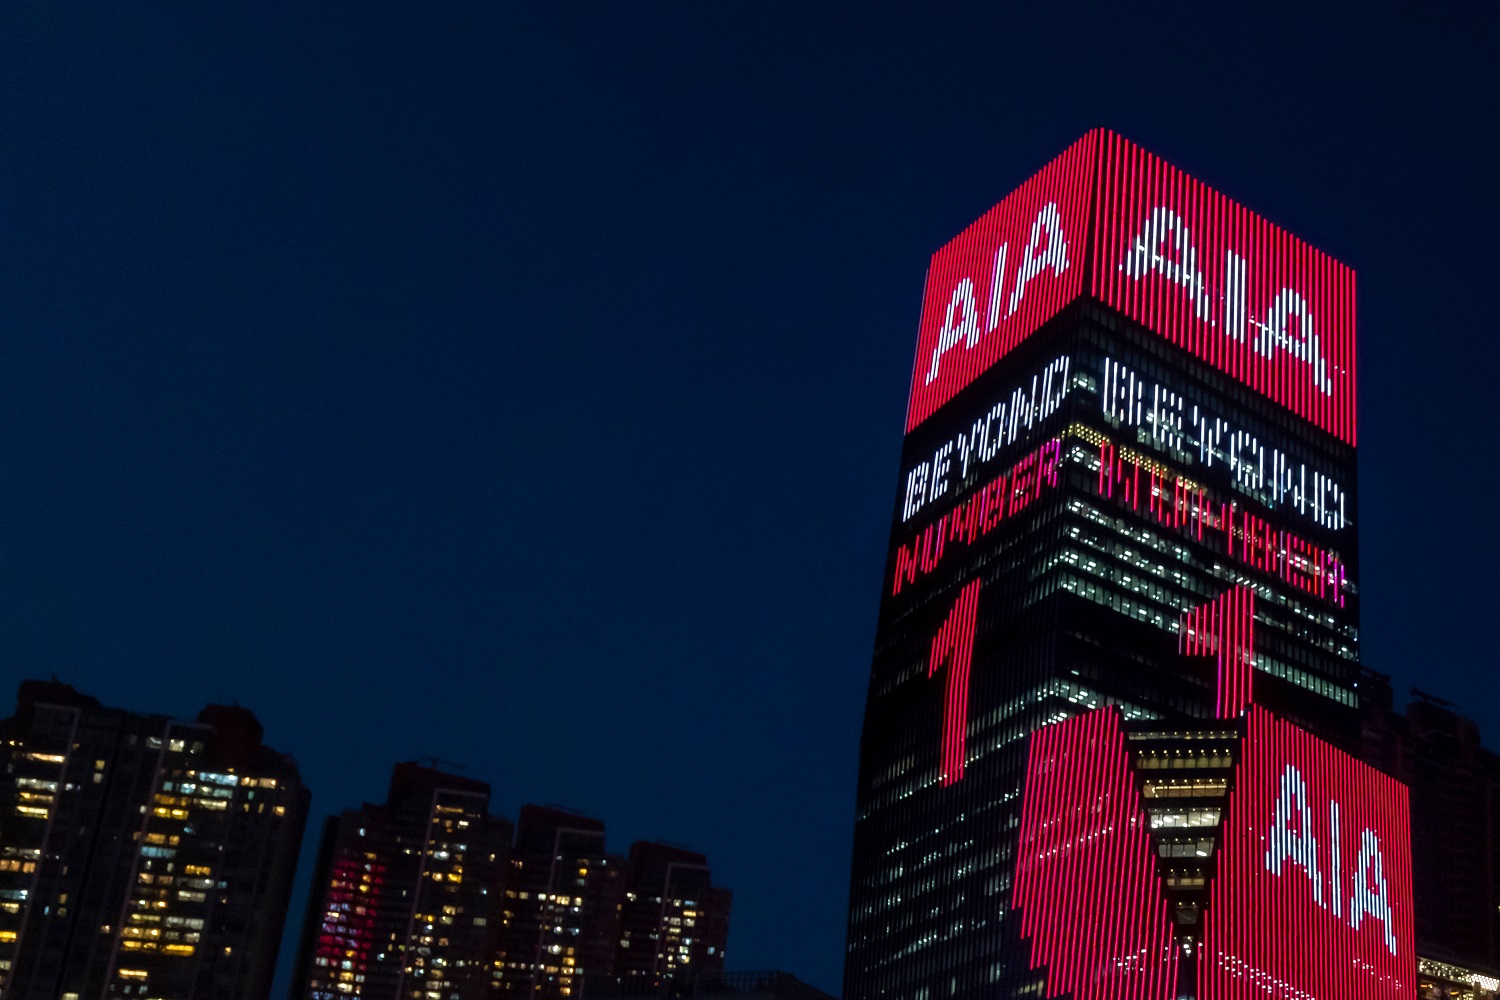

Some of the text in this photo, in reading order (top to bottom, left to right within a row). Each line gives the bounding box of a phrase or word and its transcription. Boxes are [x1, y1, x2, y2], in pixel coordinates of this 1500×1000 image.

[925, 201, 1070, 386] AIA
[1119, 206, 1332, 397] AIA
[893, 437, 1061, 597] NUMBER
[903, 355, 1070, 522] BEYOND
[1098, 440, 1345, 608] NUMBER
[1103, 357, 1345, 530] BEYOND
[928, 576, 981, 788] 1
[1265, 763, 1397, 957] AIA
